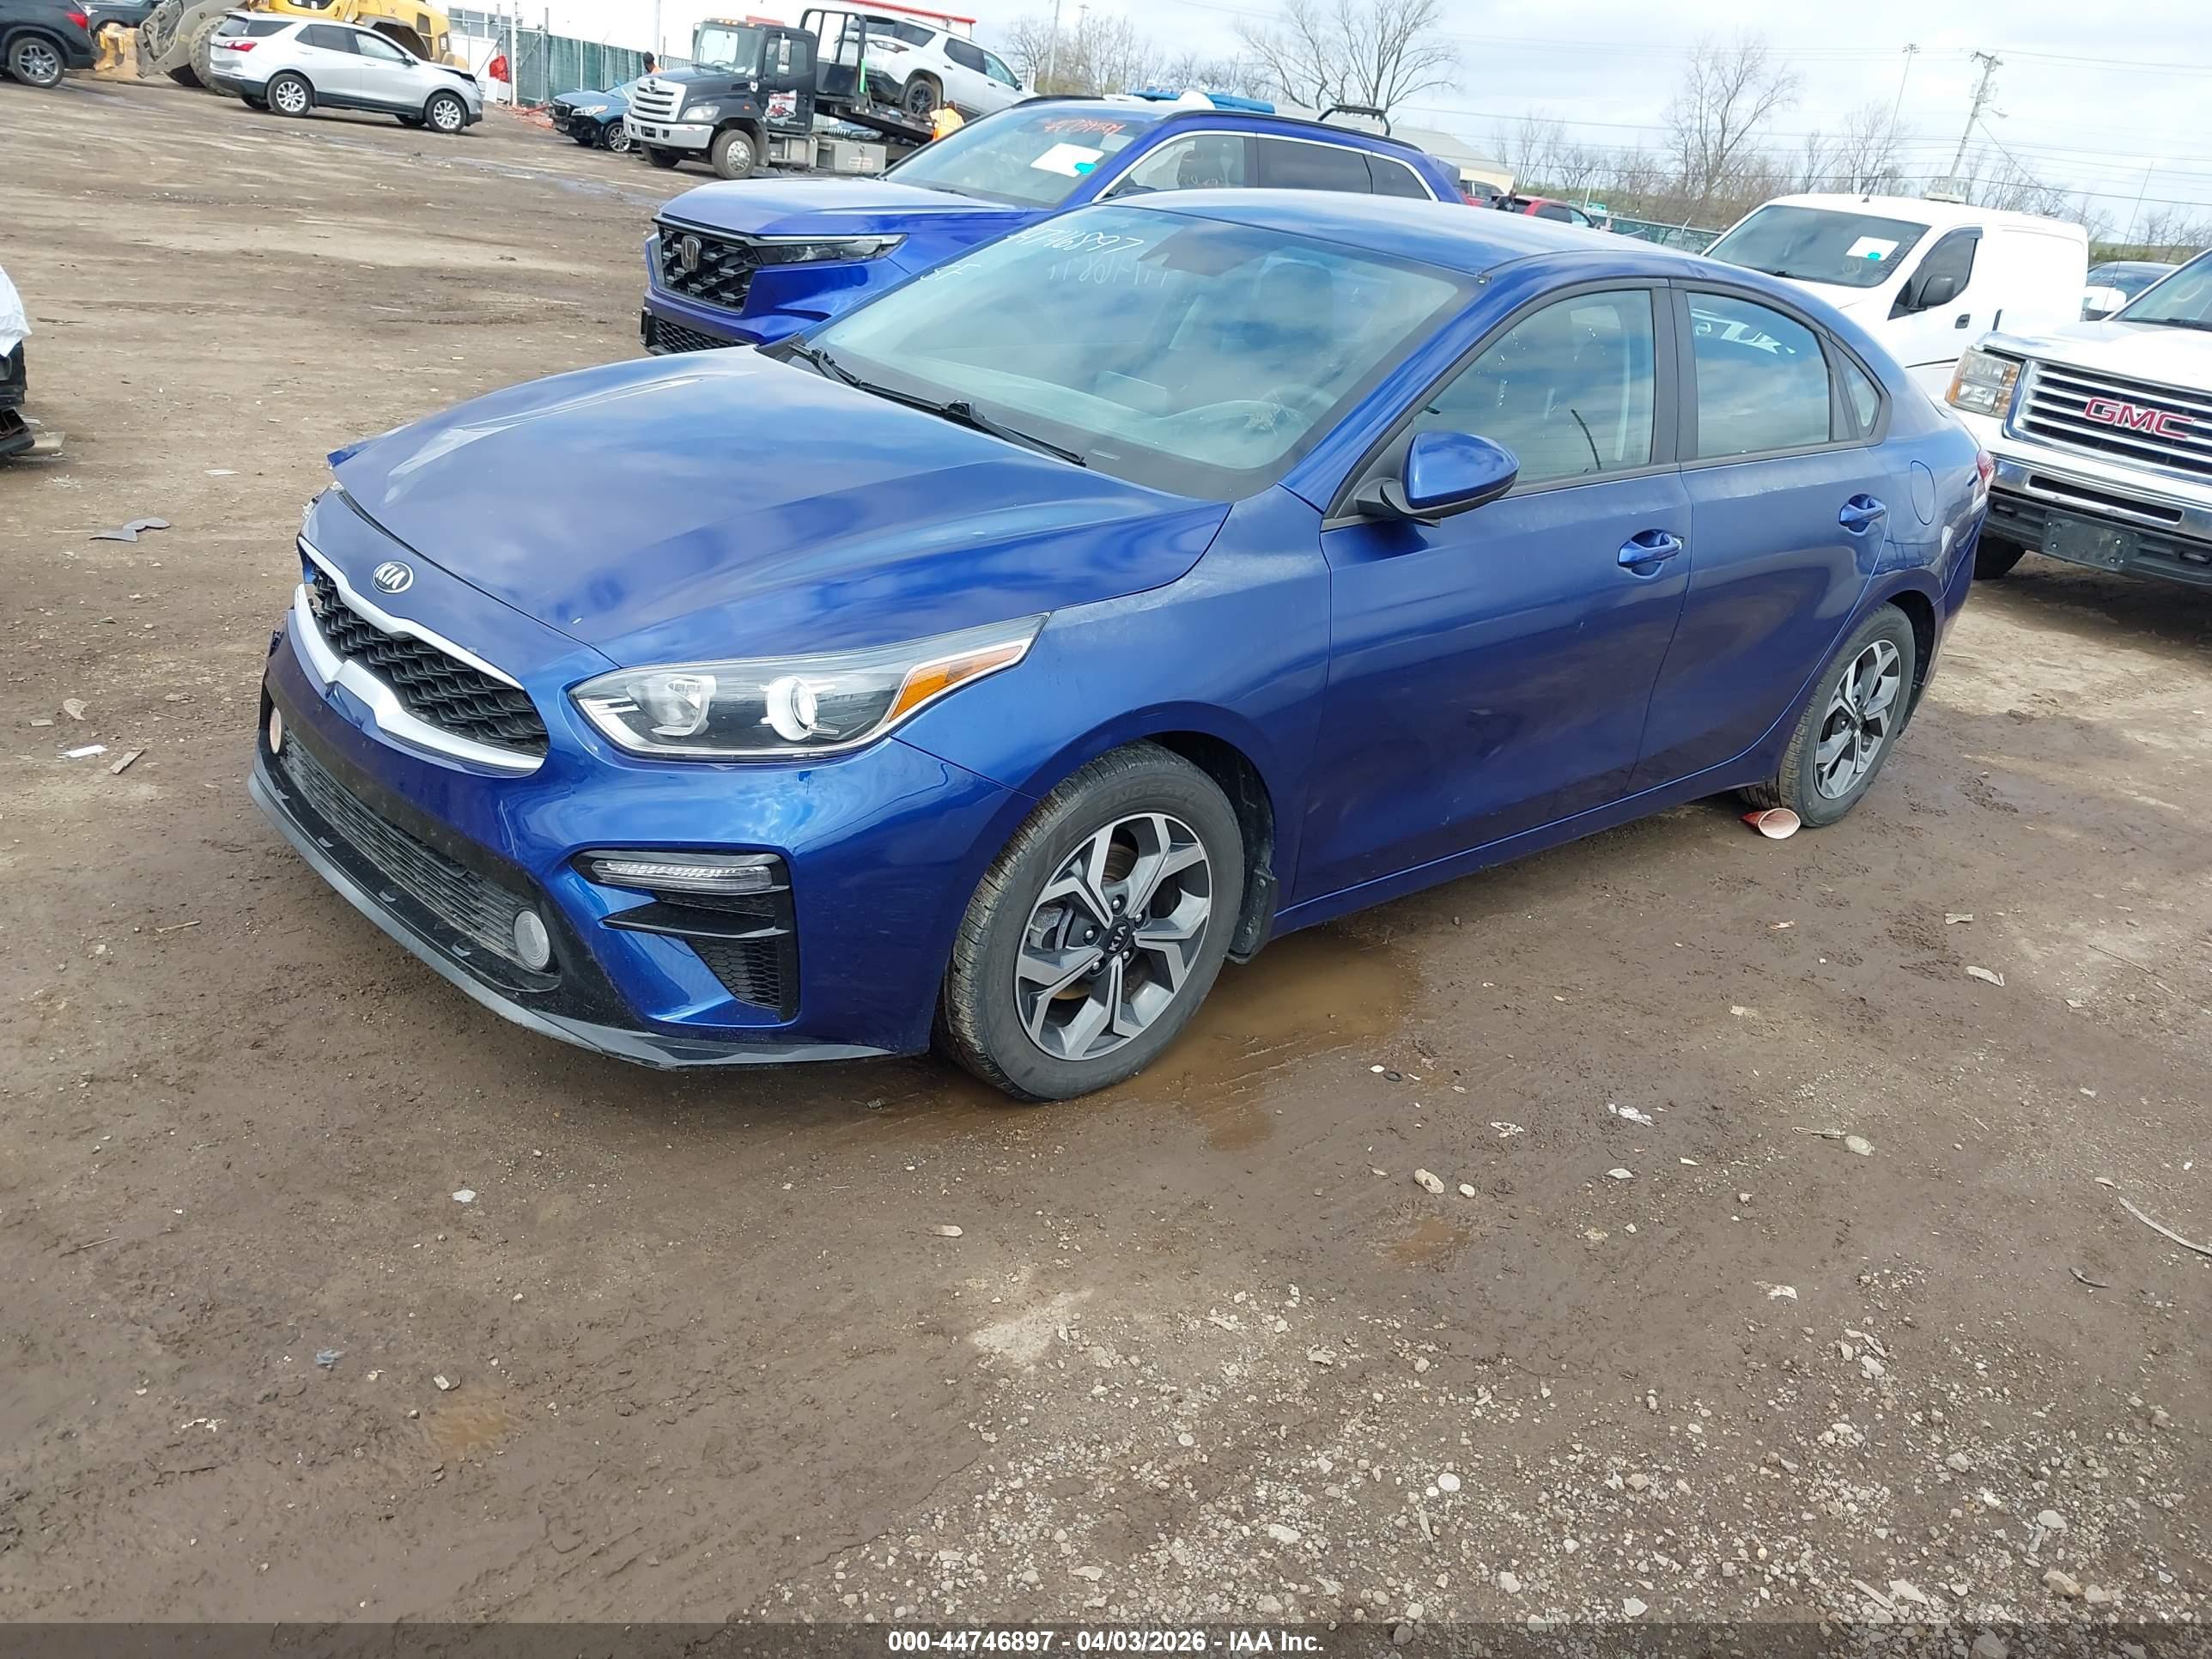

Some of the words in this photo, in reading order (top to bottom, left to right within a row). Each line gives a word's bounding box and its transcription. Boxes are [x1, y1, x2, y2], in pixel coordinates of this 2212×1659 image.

[2084, 396, 2197, 441] GMC
[375, 562, 406, 590] KIA
[1109, 925, 1127, 951] KIA
